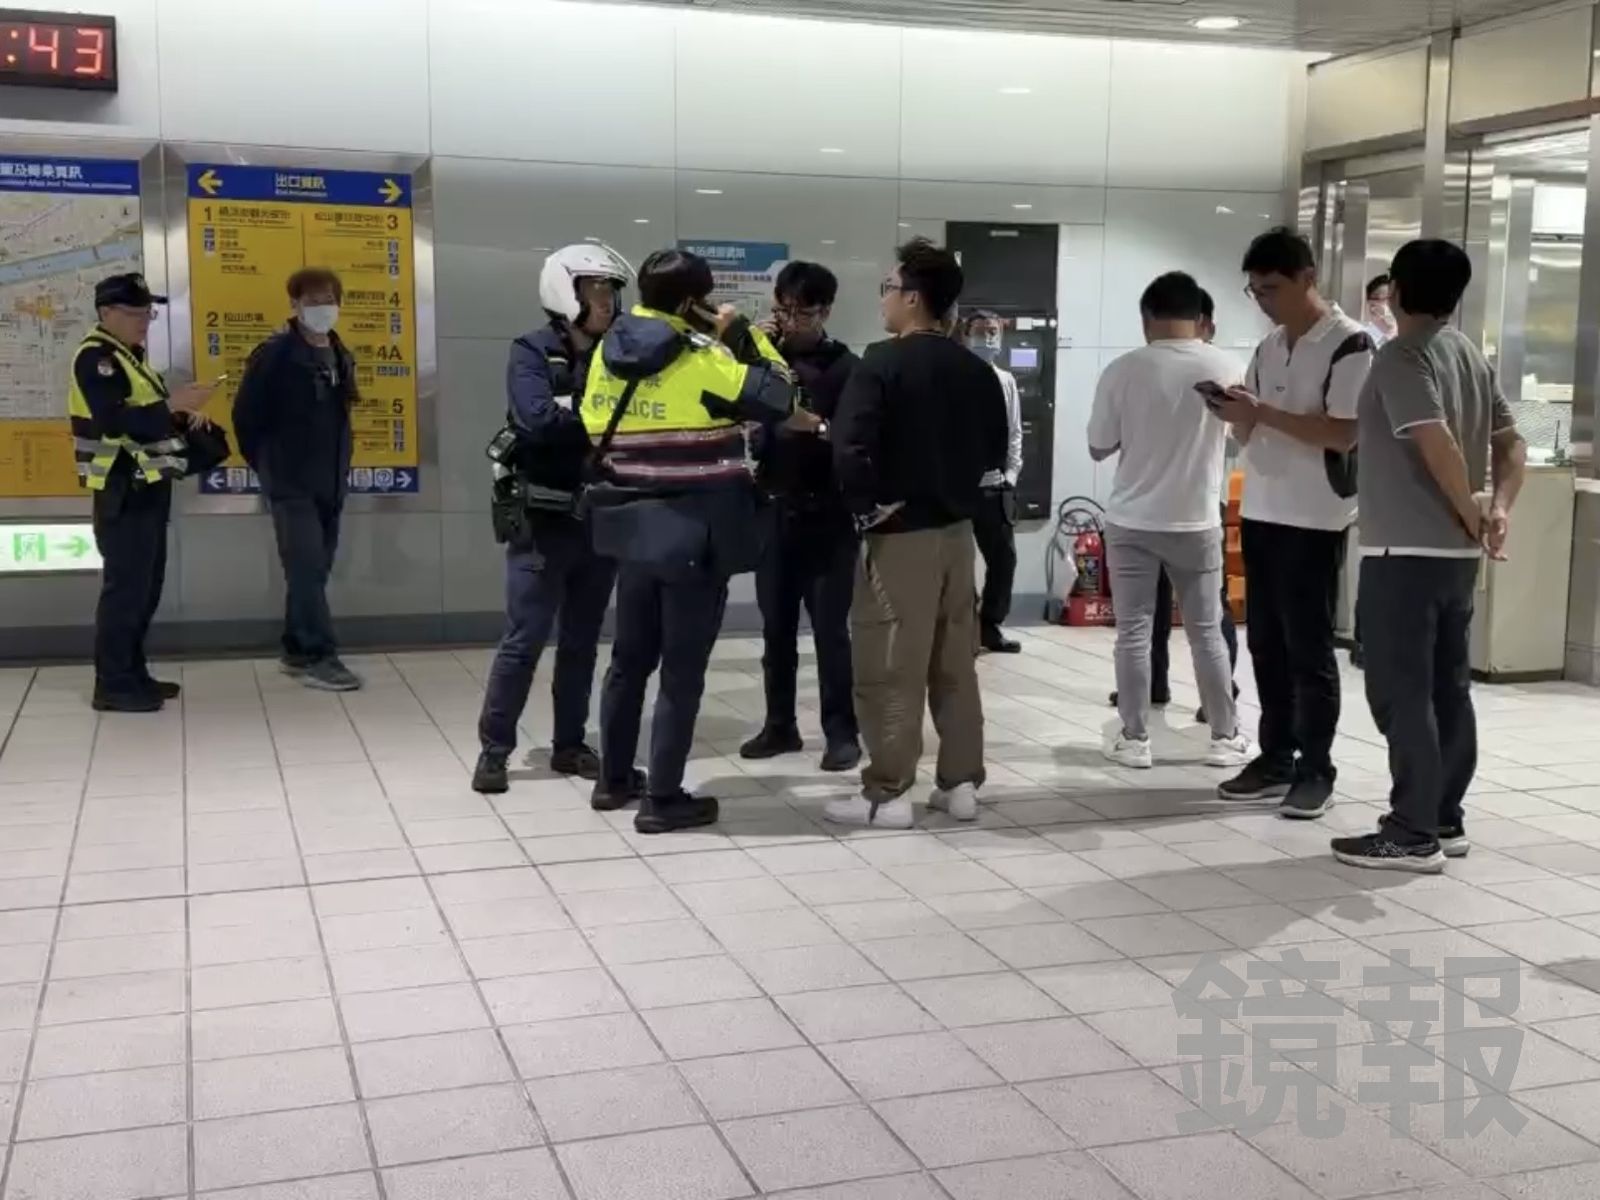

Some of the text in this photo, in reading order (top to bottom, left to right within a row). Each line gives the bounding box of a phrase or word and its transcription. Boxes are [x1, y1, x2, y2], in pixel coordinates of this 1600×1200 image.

[204, 206, 212, 222] 1
[387, 214, 398, 230] 3
[389, 291, 400, 307] 4
[206, 311, 219, 327] 2
[377, 344, 403, 360] 4A
[392, 398, 404, 414] 5
